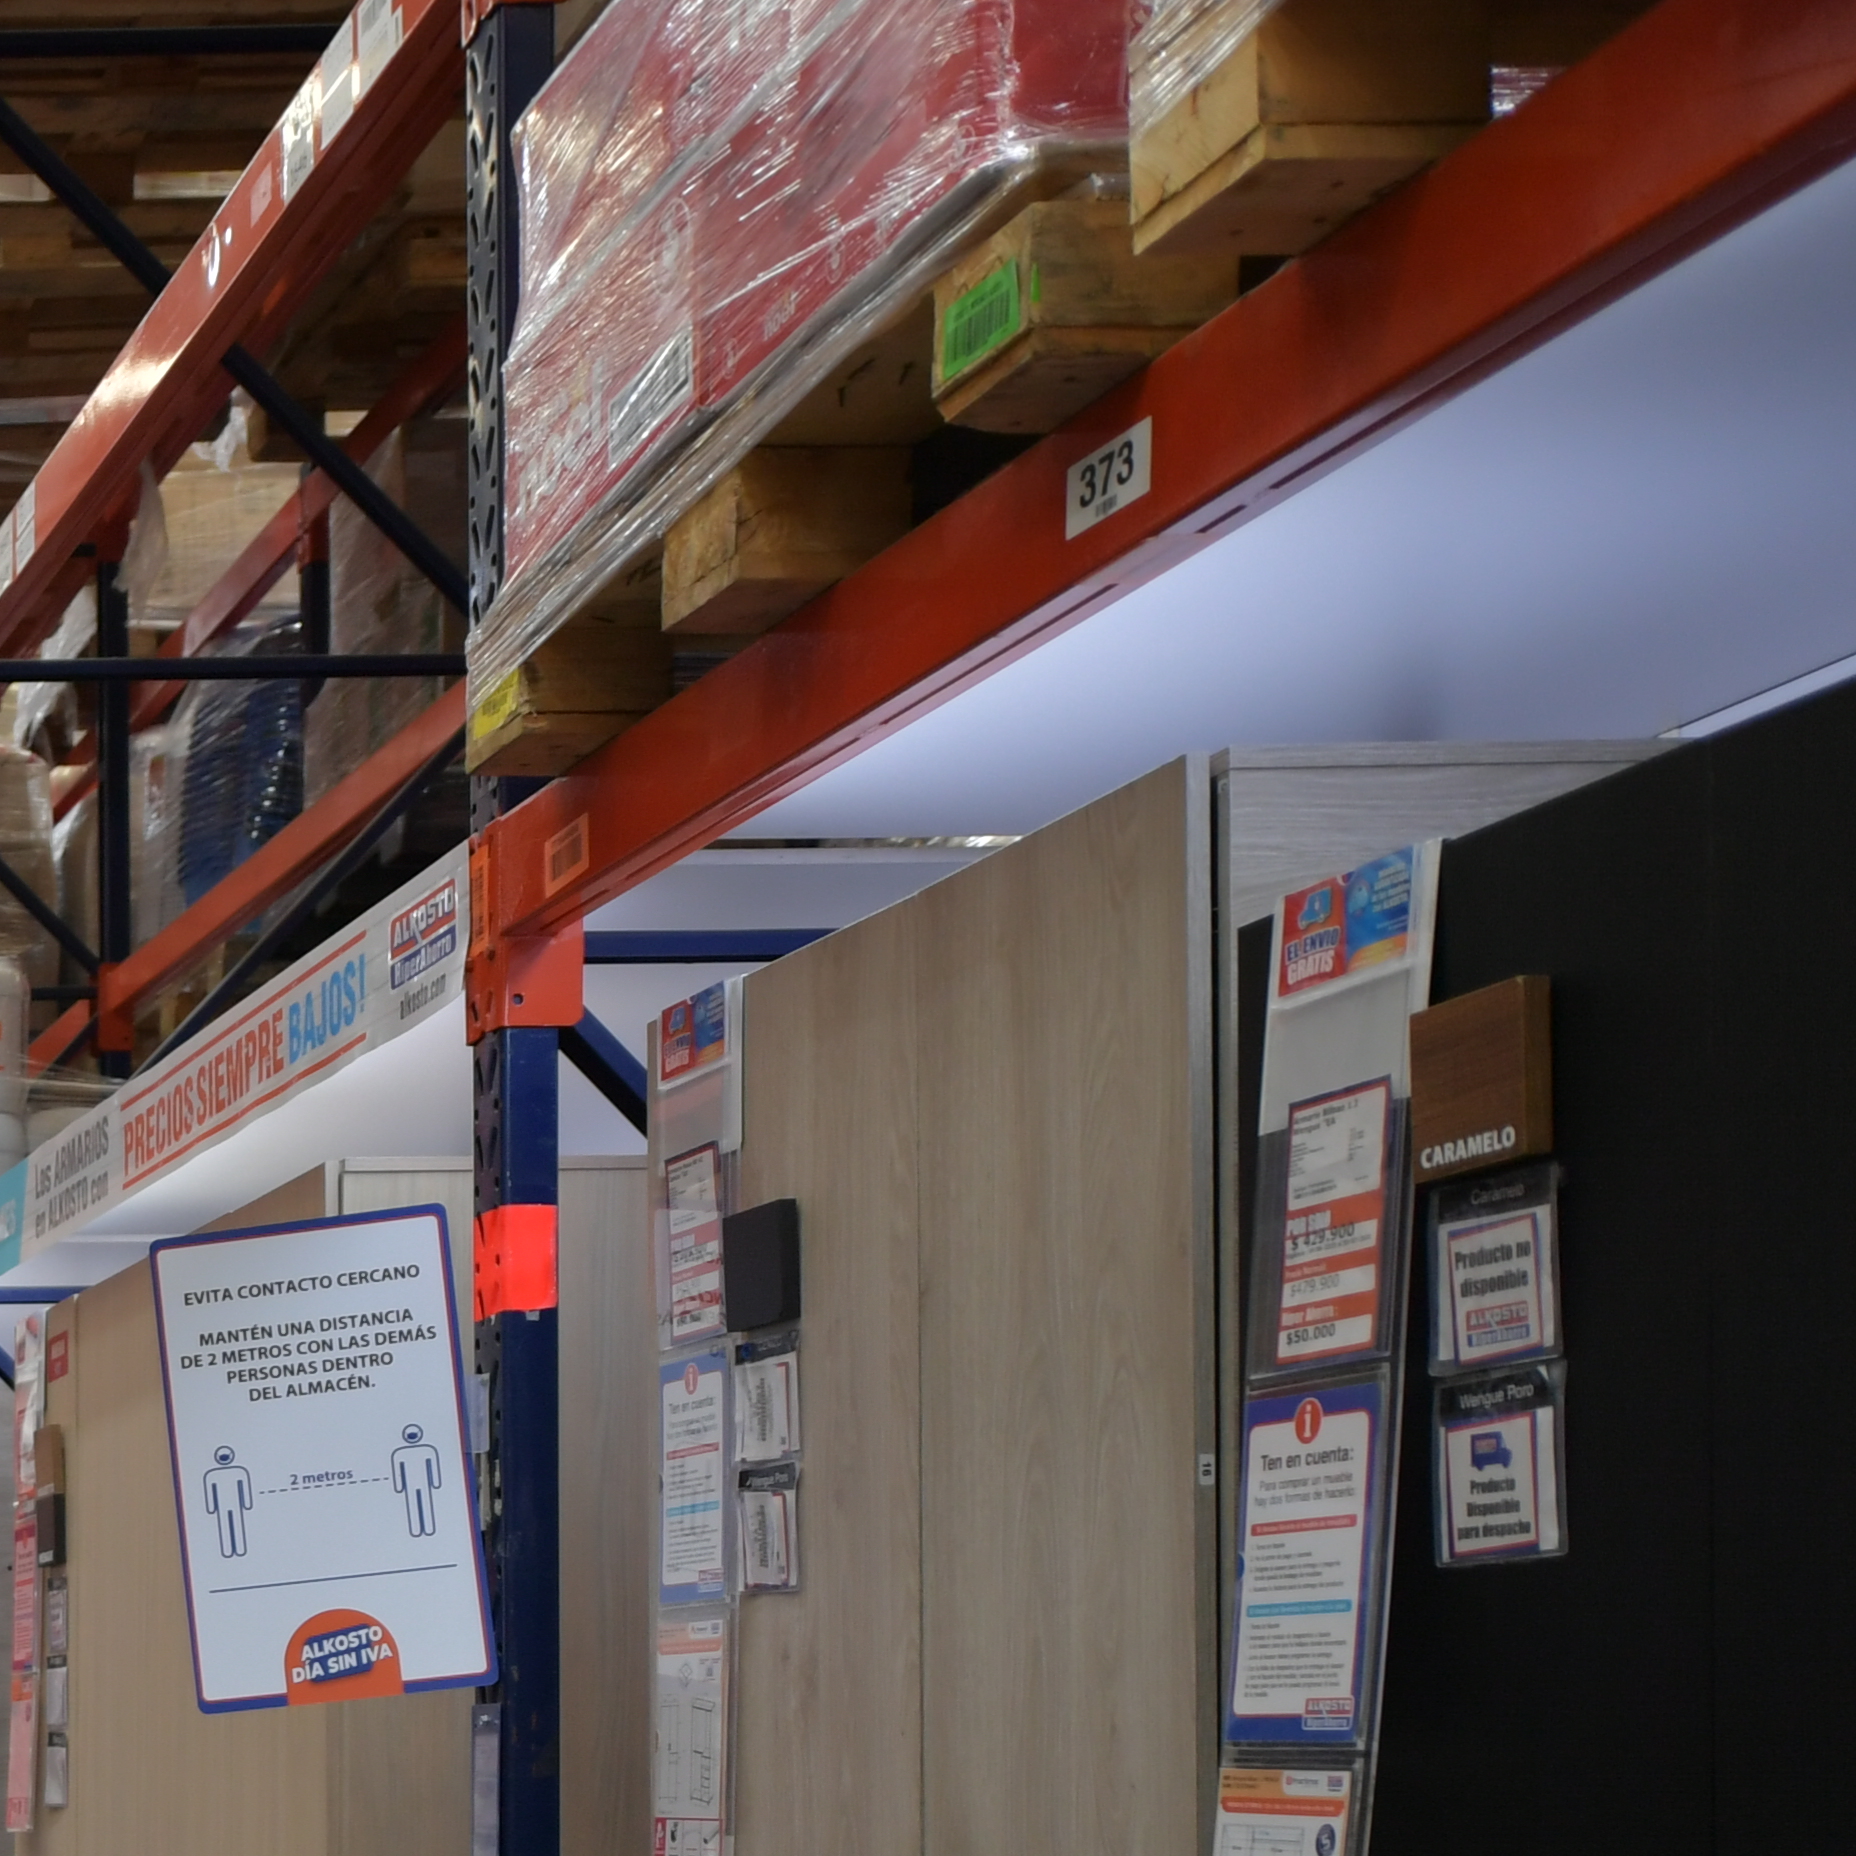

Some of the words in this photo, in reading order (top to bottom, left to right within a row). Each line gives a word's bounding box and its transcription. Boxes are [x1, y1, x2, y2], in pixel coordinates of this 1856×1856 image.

[1078, 440, 1134, 509] 373
[393, 884, 455, 950] ALKOSTO
[1288, 949, 1335, 985] GRATIS
[123, 1077, 194, 1177] PRECIOS
[194, 1007, 285, 1128] SIEMPRE
[288, 954, 368, 1065] BAJOS!
[34, 1164, 52, 1200] Los
[54, 1115, 109, 1188] ARMARIOS
[1420, 1125, 1516, 1170] CARAMELO
[35, 1210, 47, 1239] en
[48, 1175, 88, 1232] ALKOSTO
[90, 1170, 109, 1206] con
[1302, 1222, 1356, 1248] 429.900
[1454, 1245, 1513, 1271] Producto
[1516, 1240, 1531, 1260] no
[183, 1287, 234, 1307] EVITA
[237, 1275, 333, 1301] CONTACTO
[336, 1264, 421, 1288] CERCANO
[1460, 1268, 1529, 1299] disponible
[199, 1322, 274, 1348] MANTÉN
[277, 1319, 317, 1339] UNA
[319, 1308, 414, 1333] DISTANCIA
[1469, 1304, 1527, 1327] ALKOSTO
[180, 1354, 204, 1370] DE
[207, 1352, 218, 1367] 2
[221, 1342, 293, 1366] METROS
[296, 1338, 335, 1357] CON
[338, 1334, 371, 1352] LAS
[374, 1323, 437, 1347] DEMÁS
[1286, 1323, 1336, 1346] $50.000
[226, 1360, 319, 1385] PERSONAS
[322, 1350, 394, 1374] DENTRO
[249, 1385, 282, 1402] DEL
[285, 1373, 377, 1399] ALMACÉN.
[1460, 1389, 1505, 1410] Wengue
[1507, 1383, 1534, 1401] Poro
[289, 1473, 299, 1486] 2
[302, 1467, 354, 1485] metros
[1261, 1454, 1283, 1472] Ten
[1286, 1454, 1301, 1469] en
[1305, 1446, 1354, 1467] cuenta:
[1482, 1520, 1532, 1539] despacho
[301, 1625, 384, 1662] ALKOSTO
[291, 1654, 325, 1684] DÍA
[327, 1651, 358, 1677] SIN
[359, 1641, 393, 1668] IVA
